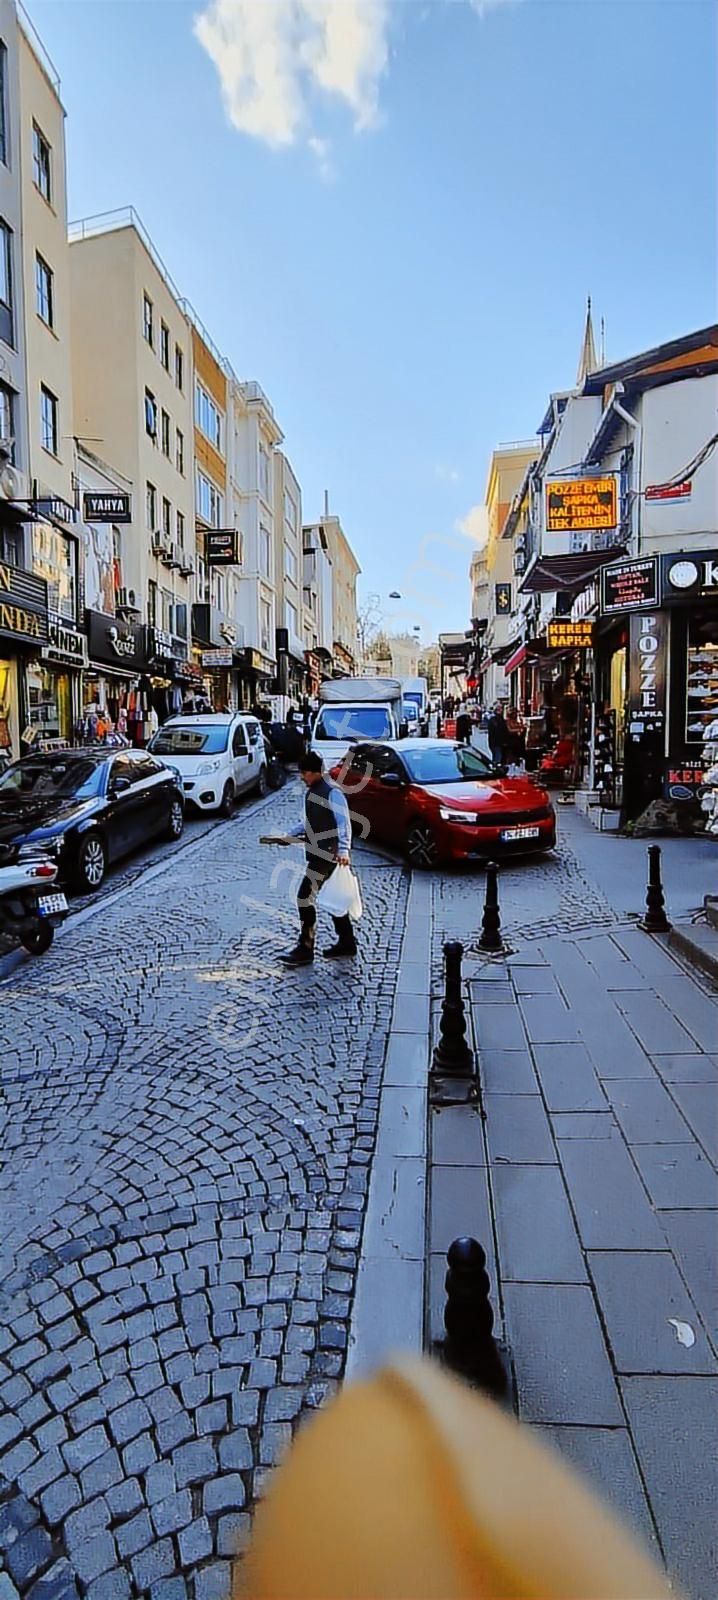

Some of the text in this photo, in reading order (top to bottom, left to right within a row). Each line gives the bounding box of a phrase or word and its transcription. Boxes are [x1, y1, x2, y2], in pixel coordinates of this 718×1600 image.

[547, 483, 583, 495] POZZE
[91, 499, 124, 512] YAHYA
[549, 518, 570, 529] TEK
[638, 616, 658, 708] POZZE
